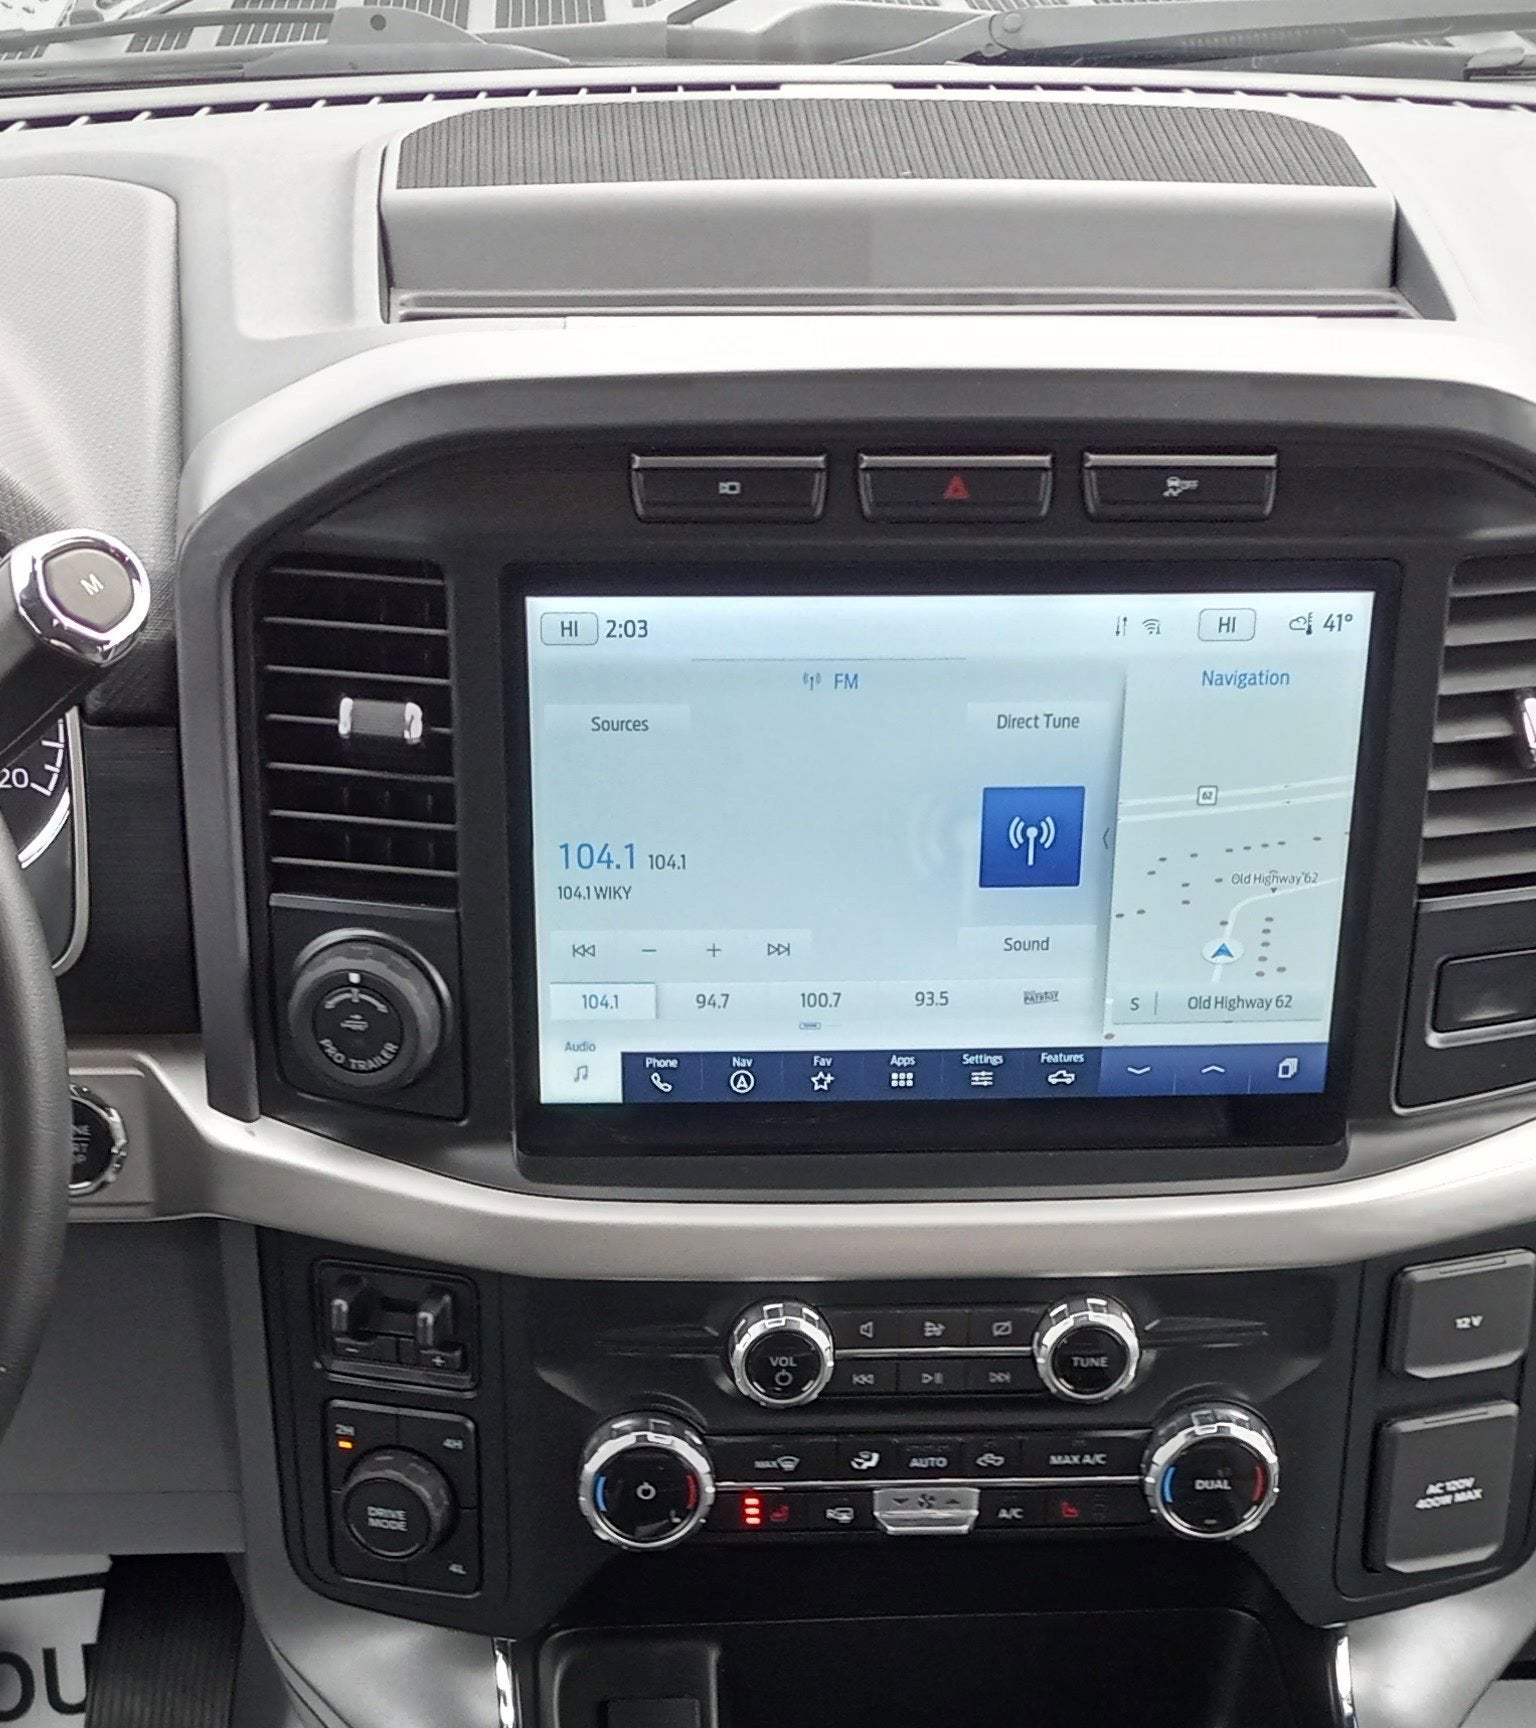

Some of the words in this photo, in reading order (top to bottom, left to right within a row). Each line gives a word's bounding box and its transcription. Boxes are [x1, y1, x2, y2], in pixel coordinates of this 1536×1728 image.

[81, 571, 104, 596] M
[560, 620, 579, 638] HI
[605, 620, 649, 639] 2:03
[1218, 617, 1236, 634] HI
[833, 673, 859, 690] FM
[1201, 669, 1291, 690] Navigation
[590, 716, 650, 733] Sources
[996, 713, 1040, 730] Direct
[1043, 713, 1080, 730] Tune
[558, 842, 637, 870] 104.1
[647, 853, 687, 871] 104.1
[1231, 872, 1251, 885] Old
[1253, 872, 1301, 889] Highway
[1304, 872, 1319, 884] 62
[557, 885, 591, 901] 104.1
[594, 885, 632, 900] WIKY
[1003, 937, 1050, 952] Sound
[581, 994, 620, 1010] 104.1
[695, 993, 730, 1009] 94.7
[800, 992, 842, 1009] 100.7
[914, 991, 949, 1007] 93.5
[1130, 997, 1140, 1011] S
[1188, 996, 1211, 1011] Old
[1213, 995, 1274, 1015] Highway
[1275, 994, 1293, 1009] 62
[319, 1038, 346, 1064] PRO
[349, 1042, 400, 1070] TRAILER
[564, 1040, 597, 1053] Audio
[645, 1056, 678, 1071] Phone
[732, 1056, 753, 1068] Nav
[813, 1055, 832, 1067] Fav
[889, 1054, 916, 1069] Apps
[962, 1053, 1003, 1067] Settings
[1040, 1052, 1085, 1065] Features
[769, 1356, 797, 1367] VOL
[1072, 1357, 1108, 1369] TUNE
[909, 1456, 948, 1468] AUTO
[1049, 1454, 1081, 1466] MAX
[1081, 1453, 1107, 1465] A/C
[1194, 1479, 1231, 1491] DUAL
[367, 1506, 406, 1520] DRIVE
[998, 1508, 1024, 1520] A/C
[368, 1517, 407, 1531] MODE
